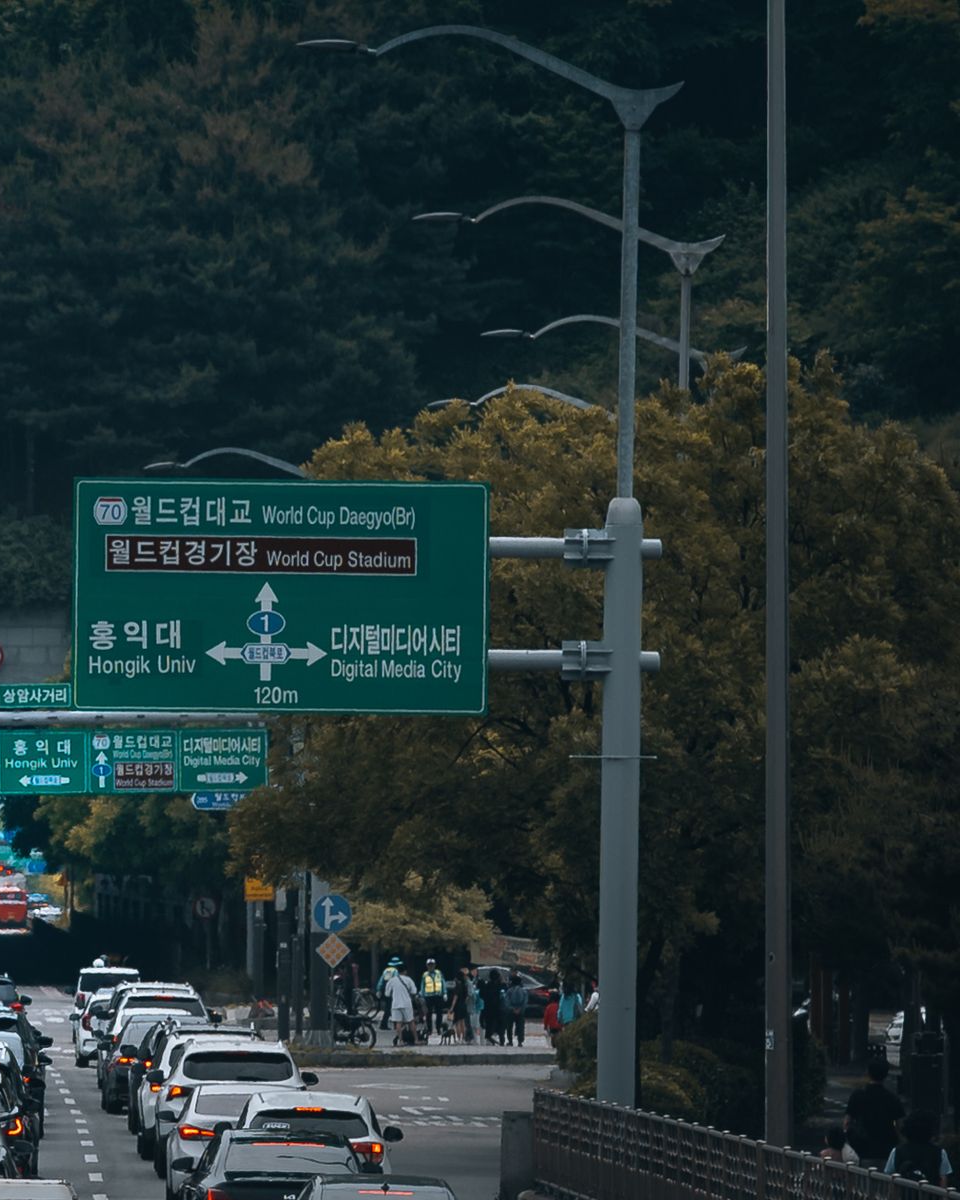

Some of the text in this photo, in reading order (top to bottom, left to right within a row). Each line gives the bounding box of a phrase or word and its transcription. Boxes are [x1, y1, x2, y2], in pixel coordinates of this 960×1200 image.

[99, 503, 123, 521] 70
[131, 496, 252, 527] 월드컵대교
[262, 506, 416, 530] World Cup Daegyo(Br)
[109, 539, 258, 566] 월드컵경기장
[266, 551, 412, 571] World Cup Stadium
[259, 614, 270, 632] 1
[88, 620, 182, 650] 홍익대
[331, 624, 461, 656] 디지털미디어시티
[88, 655, 196, 679] Hongik Univ
[331, 660, 462, 682] Digital Media City
[2, 687, 67, 704] 상암사거리
[254, 686, 299, 705] 120m
[113, 734, 173, 749] 월드컵대교
[183, 736, 261, 754] 디지털미디어시티
[5, 757, 78, 770] Hongik Univ
[183, 755, 261, 768] Digital Media City
